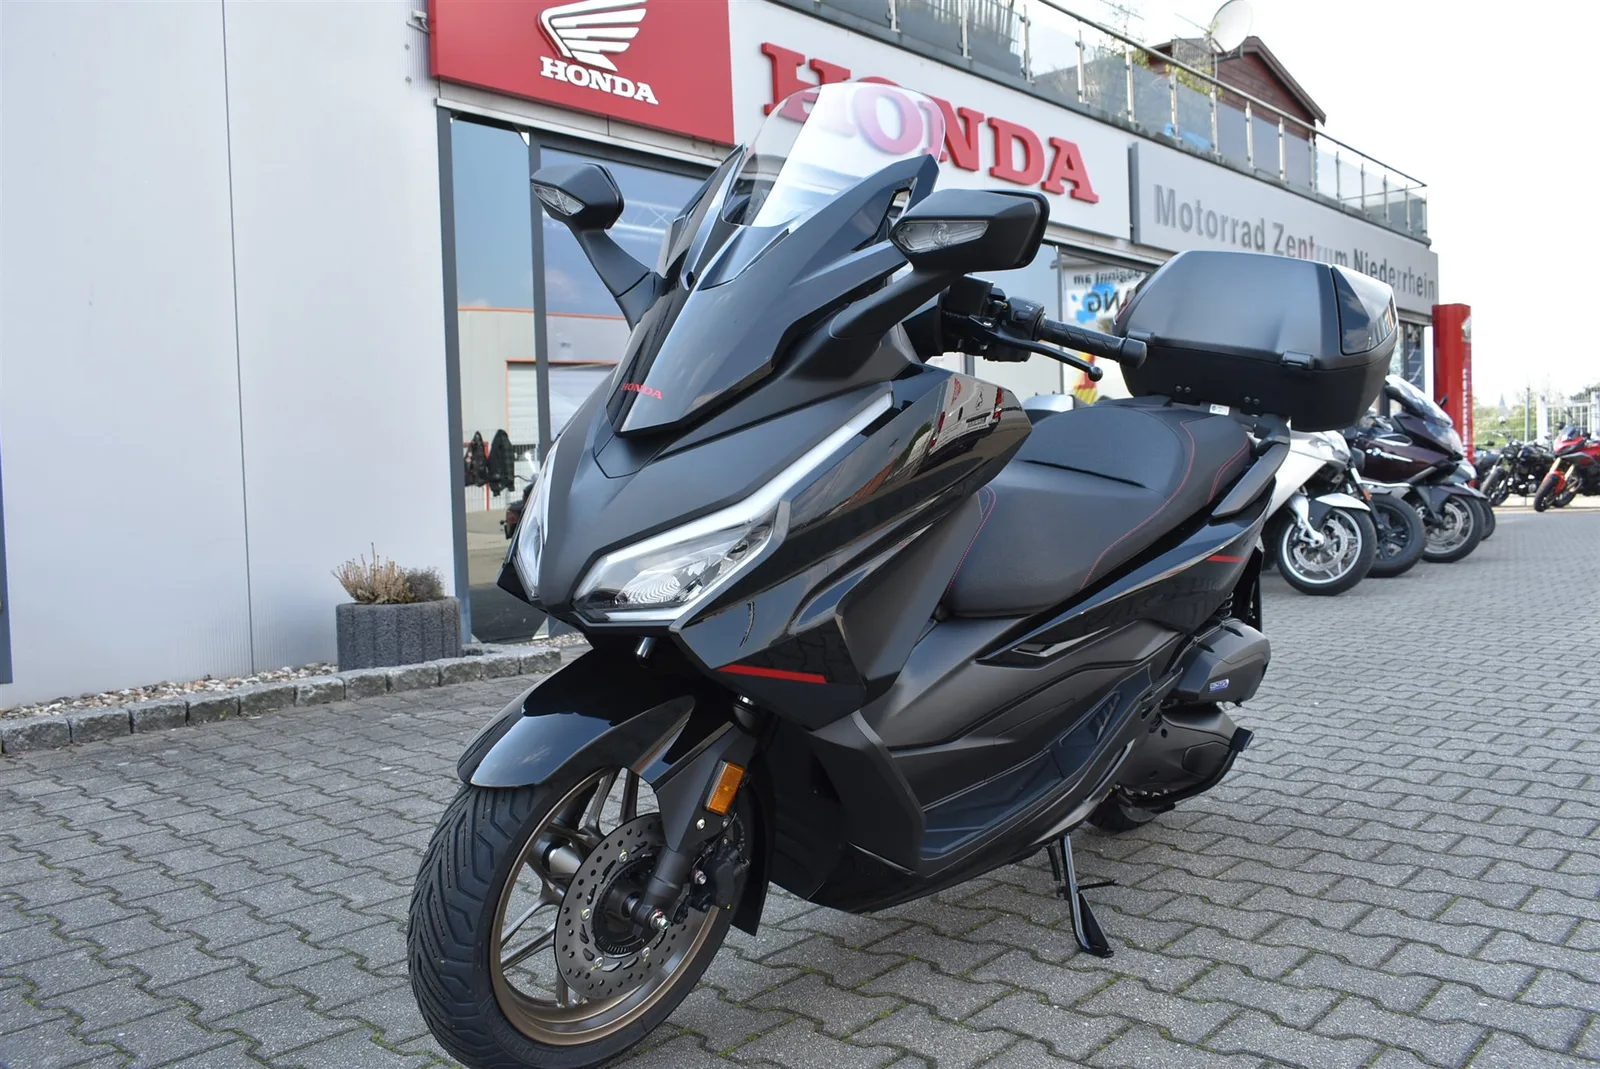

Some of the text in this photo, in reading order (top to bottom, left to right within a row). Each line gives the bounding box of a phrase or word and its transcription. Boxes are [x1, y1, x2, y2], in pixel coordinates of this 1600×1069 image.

[539, 56, 659, 105] HONDA
[761, 42, 1099, 204] HONDA
[1154, 184, 1435, 299] Motorrad Zentrum Niederrhein
[620, 382, 663, 400] HONDA
